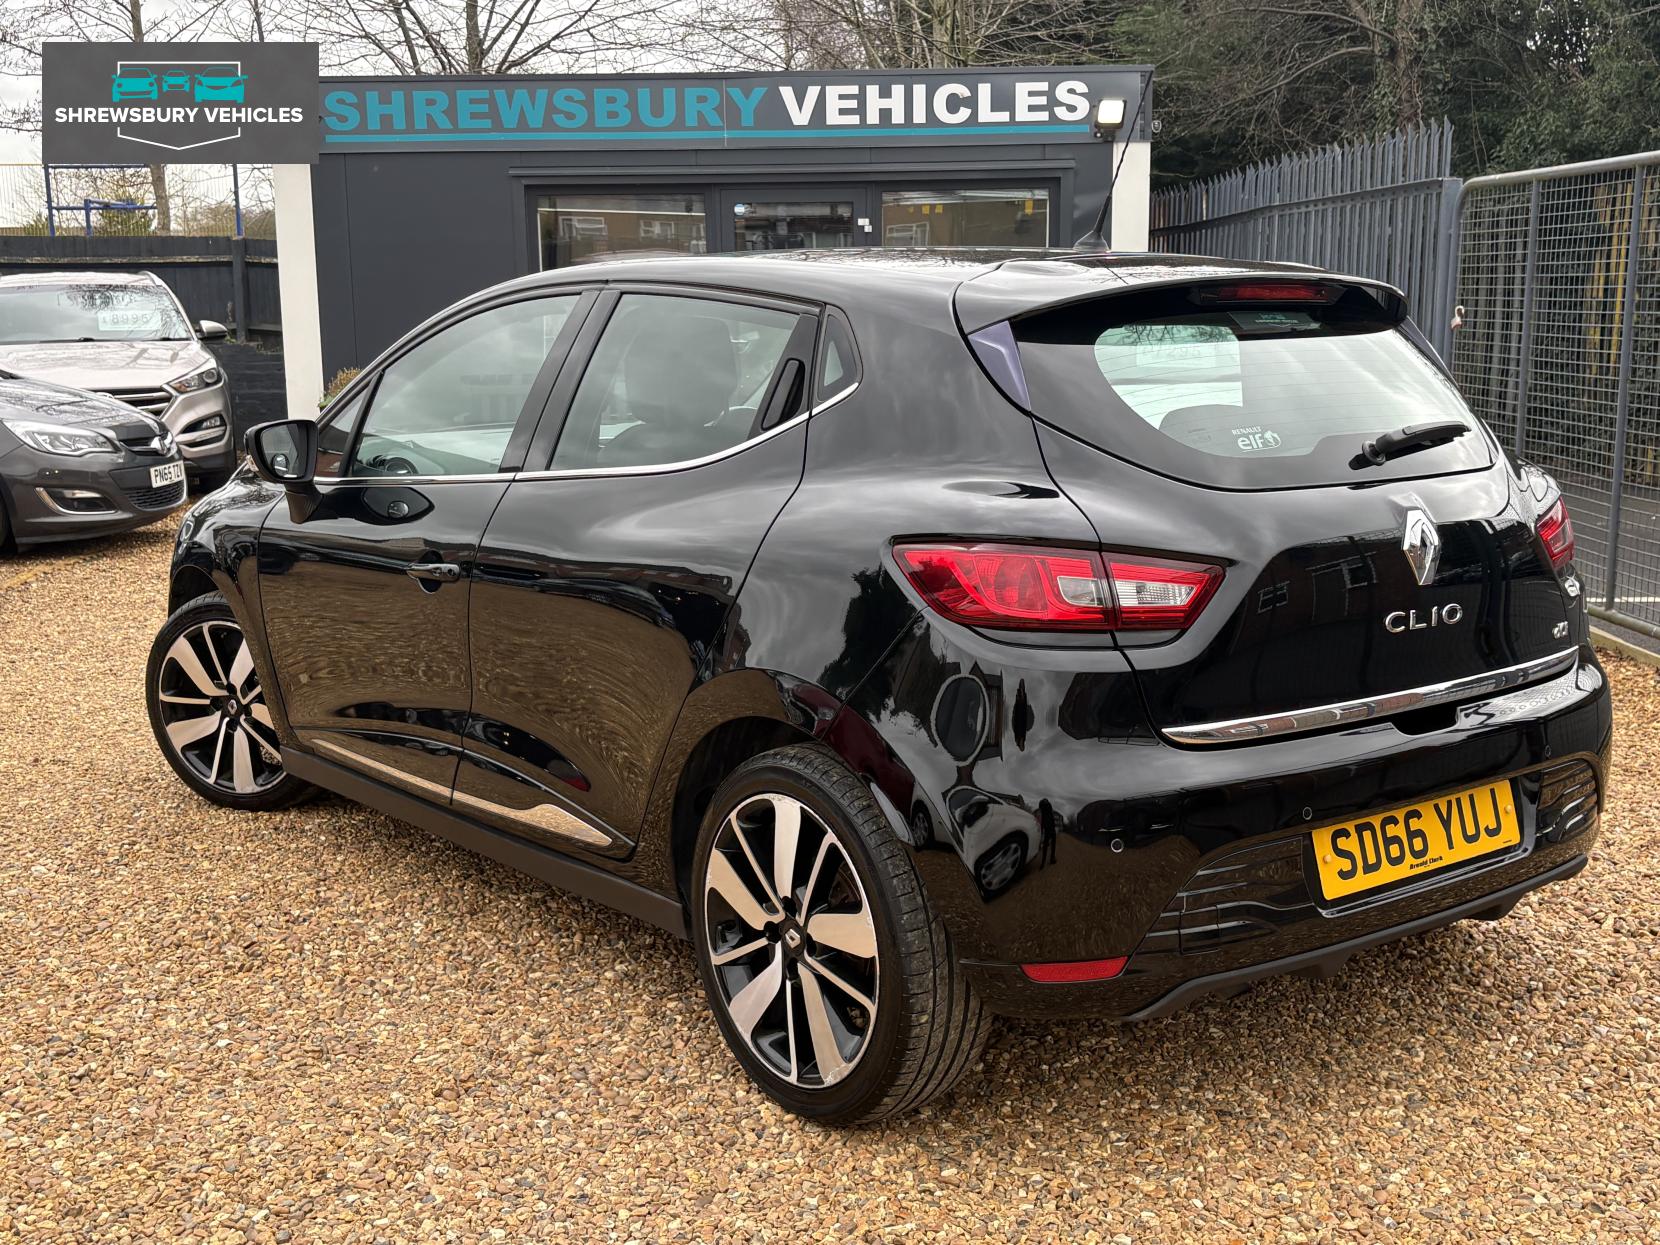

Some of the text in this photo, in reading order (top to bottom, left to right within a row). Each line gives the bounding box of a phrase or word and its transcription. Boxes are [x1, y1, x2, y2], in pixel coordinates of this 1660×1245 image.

[323, 80, 1090, 131] SHREWSBURY VEHICLES
[1231, 425, 1262, 435] RENAULT
[1237, 433, 1264, 450] elf
[1384, 603, 1464, 633] CLIO
[1330, 787, 1503, 881] SD66 YUJ
